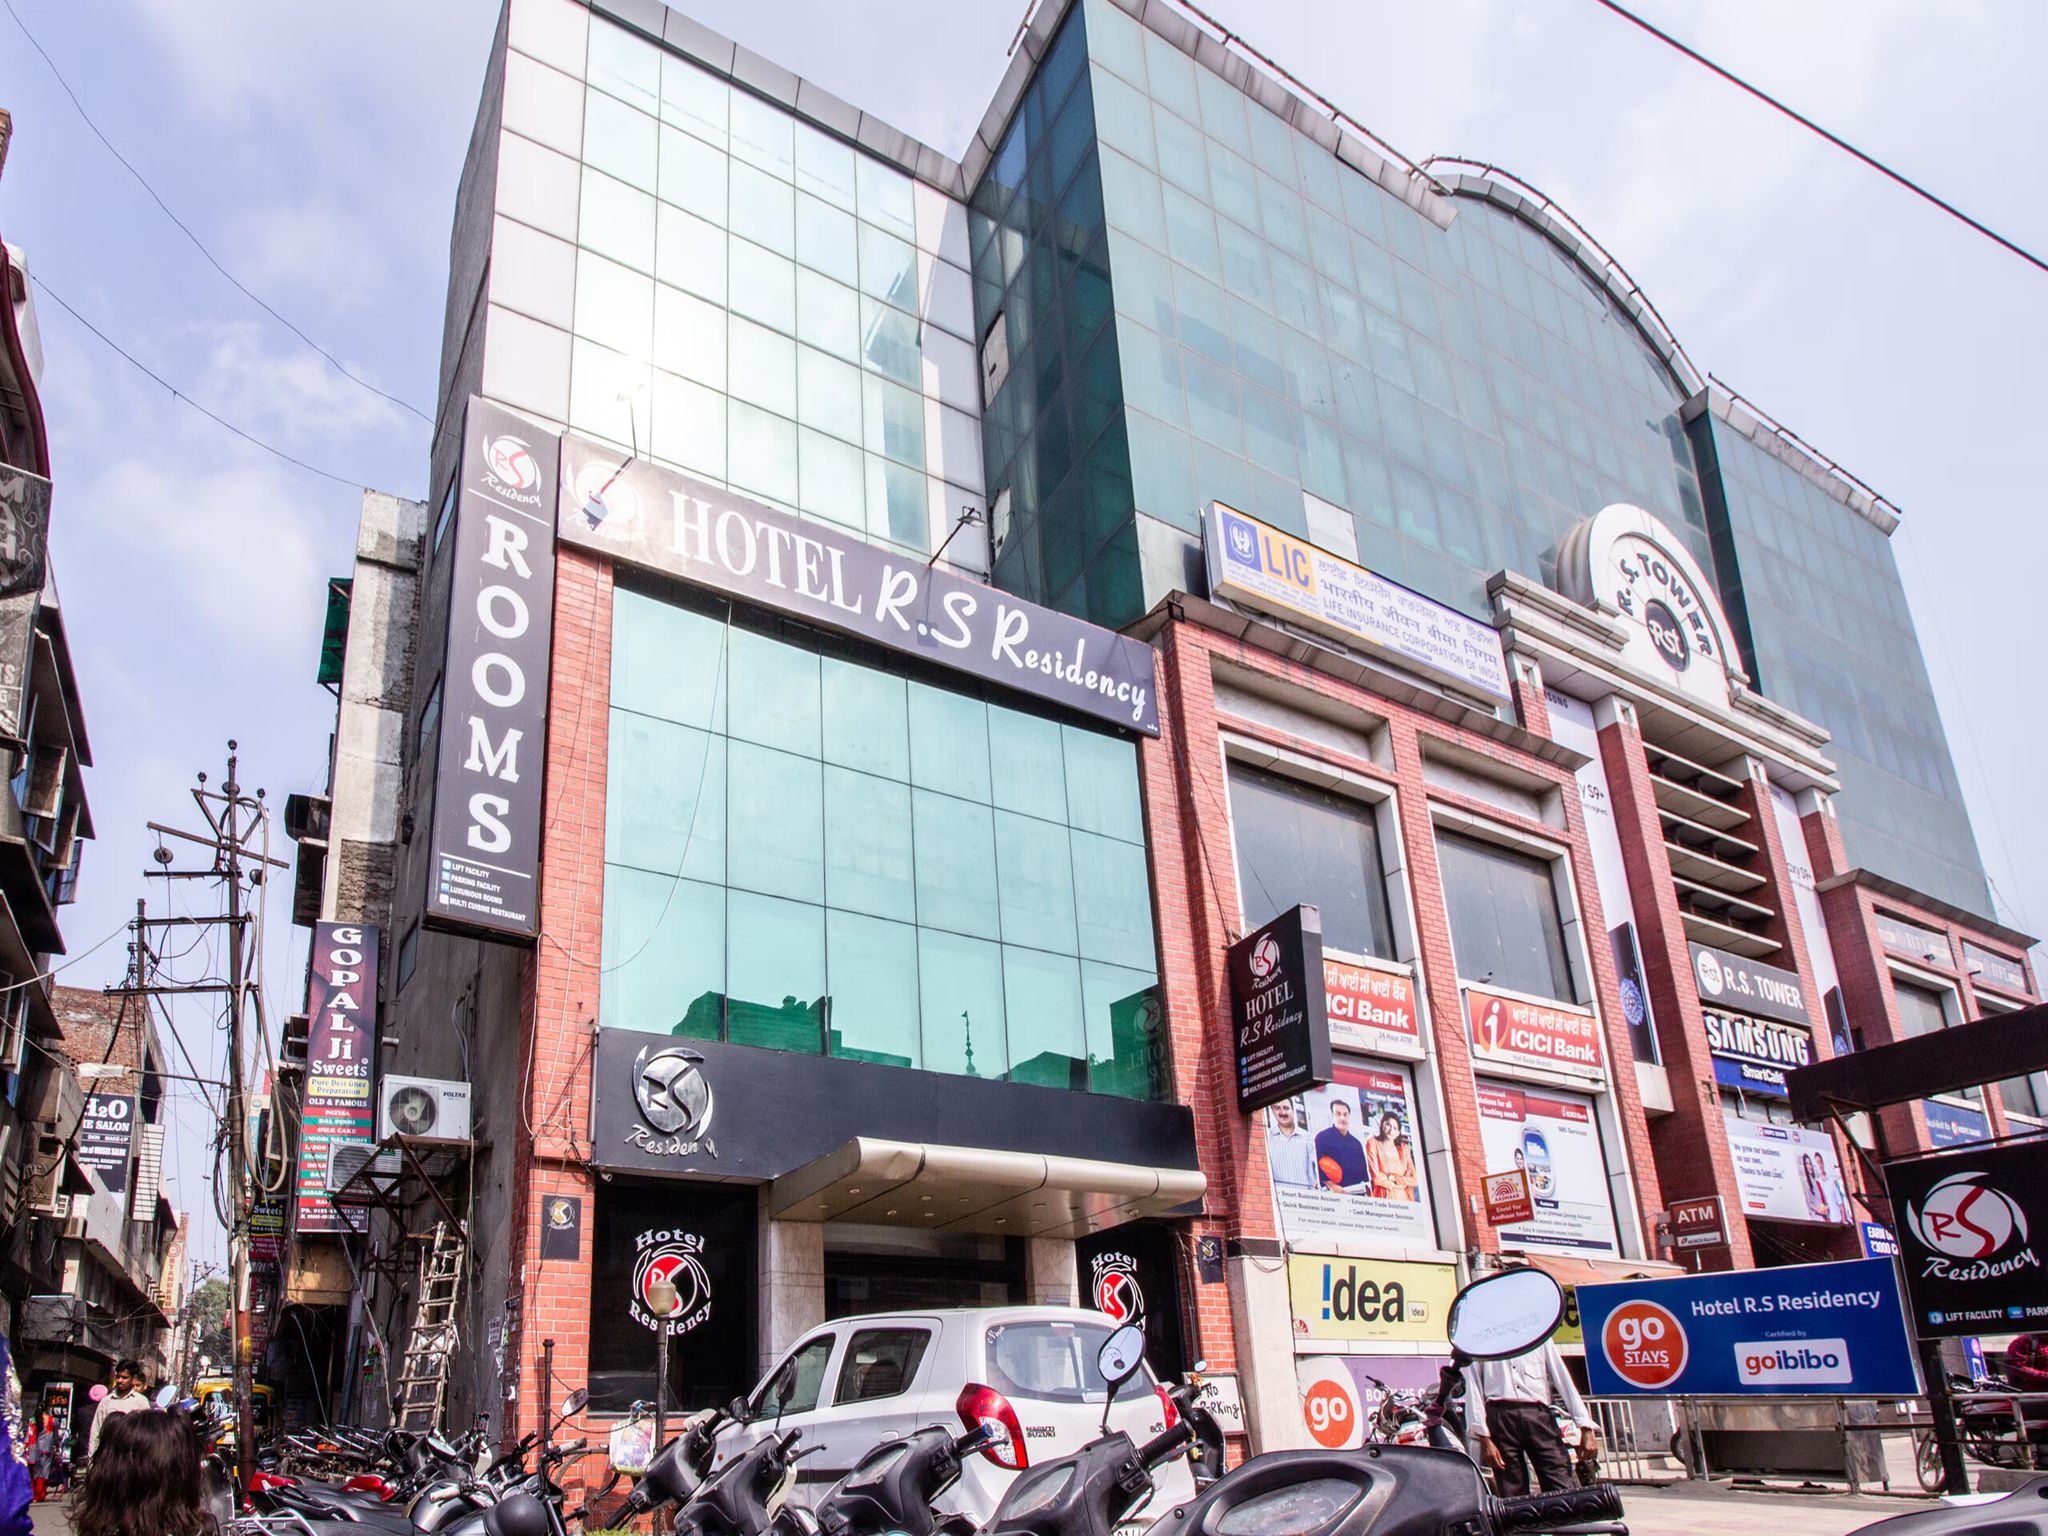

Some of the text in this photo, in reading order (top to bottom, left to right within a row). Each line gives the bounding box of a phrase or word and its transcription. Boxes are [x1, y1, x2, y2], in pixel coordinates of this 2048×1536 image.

[480, 471, 542, 508] Residency
[1264, 535, 1310, 588] LIC
[668, 489, 1146, 721] HOTEL R.S Residency
[1637, 553, 1712, 656] TOWER
[1320, 578, 1375, 612] भारतीय
[1382, 605, 1420, 633] जीवन
[1428, 623, 1457, 649] बीमा
[1463, 639, 1498, 668] निगम
[1323, 597, 1342, 616] LIFE
[1347, 607, 1400, 639] INSURANCE
[1402, 631, 1464, 666] CORPORATION
[1465, 658, 1476, 671] OF
[1479, 665, 1501, 681] INDIA
[463, 514, 532, 854] ROOMS
[1543, 690, 1568, 709] SUNG
[452, 863, 489, 878] LIFT FACILITY
[451, 874, 500, 892] PARKING FACILITY
[450, 886, 503, 905] LUXURIOUS ROOMS
[449, 898, 526, 921] MULTI CUISINE RESTAURANT
[327, 927, 363, 1032] GOPAL
[1246, 980, 1294, 1020] HOTEL
[1754, 975, 1804, 1010] TOWER
[1325, 992, 1410, 1029] ICI Bank
[1263, 1008, 1303, 1037] Residency
[1511, 1028, 1596, 1062] ICICI Bank
[1704, 1015, 1810, 1066] SAMSUNG
[1247, 1046, 1275, 1062] LIFT FACILITY
[1248, 1052, 1284, 1072] PARKING FACILITY
[311, 1060, 368, 1077] Sweets
[1248, 1062, 1287, 1083] LUXURIOUS ROOMS
[1249, 1065, 1308, 1094] MULTI CUISINE RESTAURANT
[317, 1087, 360, 1095] Preparation
[335, 1099, 367, 1107] FAMOUS
[96, 1121, 130, 1132] SALON
[1568, 1127, 1587, 1136] Services
[1298, 1192, 1319, 1200] Business
[1351, 1199, 1374, 1207] Extensive
[1388, 1202, 1410, 1210] Solutions
[1495, 1193, 1520, 1201] AADHAAR
[1299, 1203, 1320, 1211] Business
[1365, 1210, 1395, 1219] Management
[1491, 1210, 1530, 1221] Aadhaar here
[1677, 1206, 1714, 1224] ATM
[635, 1228, 705, 1253] Hotel
[1867, 1226, 1886, 1238] EARN
[1091, 1251, 1137, 1272] Hotel
[1922, 1248, 2040, 1281] Residency
[1691, 1290, 1880, 1316] Hotel R.S Residency
[629, 1299, 712, 1336] Resdency
[1945, 1309, 2003, 1322] LIFT FACILITY
[1618, 1316, 1665, 1350] go
[1765, 1329, 1806, 1338] Certified by
[1625, 1350, 1669, 1365] STAYS
[1745, 1348, 1839, 1376] goibibo
[1310, 1396, 1347, 1432] go
[1150, 1425, 1164, 1433] 800
